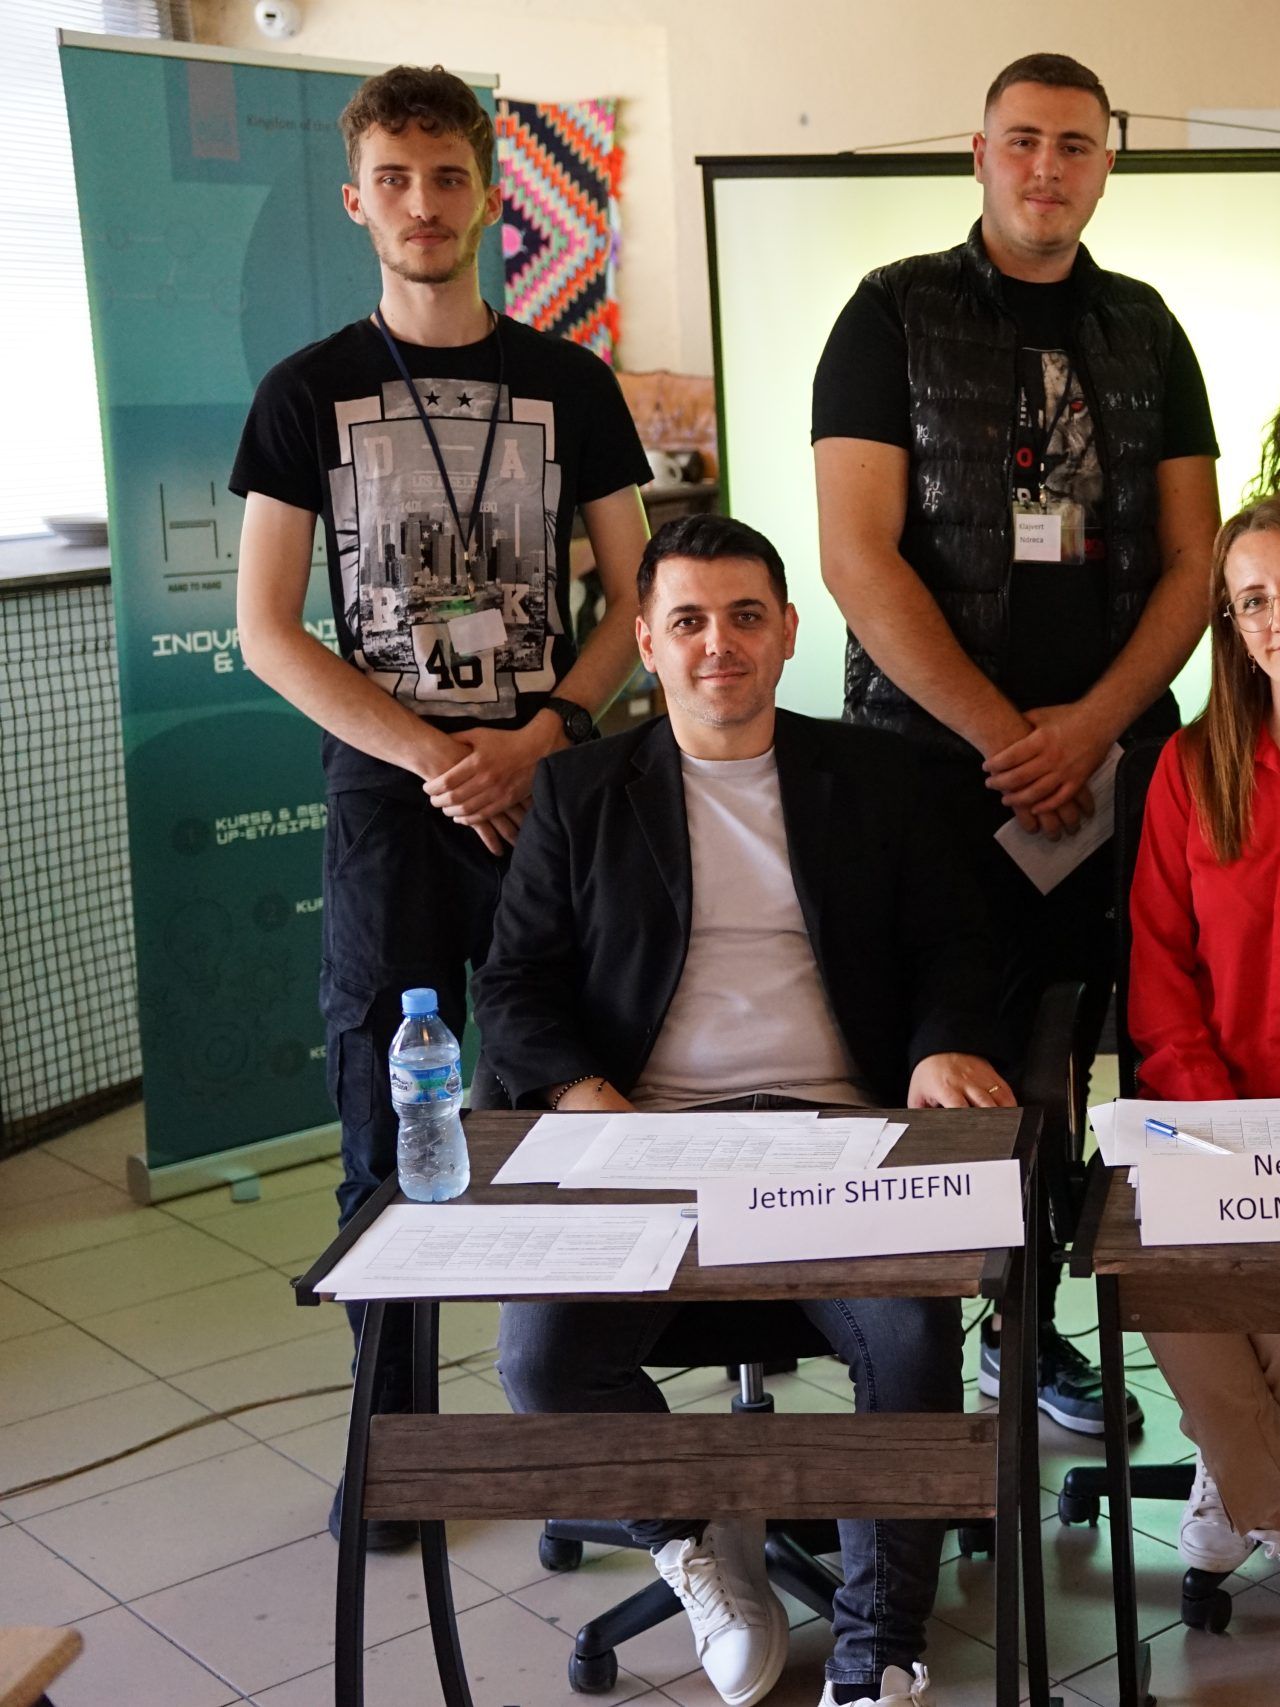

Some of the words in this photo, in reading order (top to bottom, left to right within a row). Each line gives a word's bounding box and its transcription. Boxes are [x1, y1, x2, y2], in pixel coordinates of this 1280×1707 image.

[363, 435, 393, 480] D
[500, 438, 526, 479] A
[501, 583, 530, 624] K
[213, 651, 234, 674] &
[749, 1183, 836, 1210] Jetmir
[845, 1174, 971, 1203] SHTJEFNI
